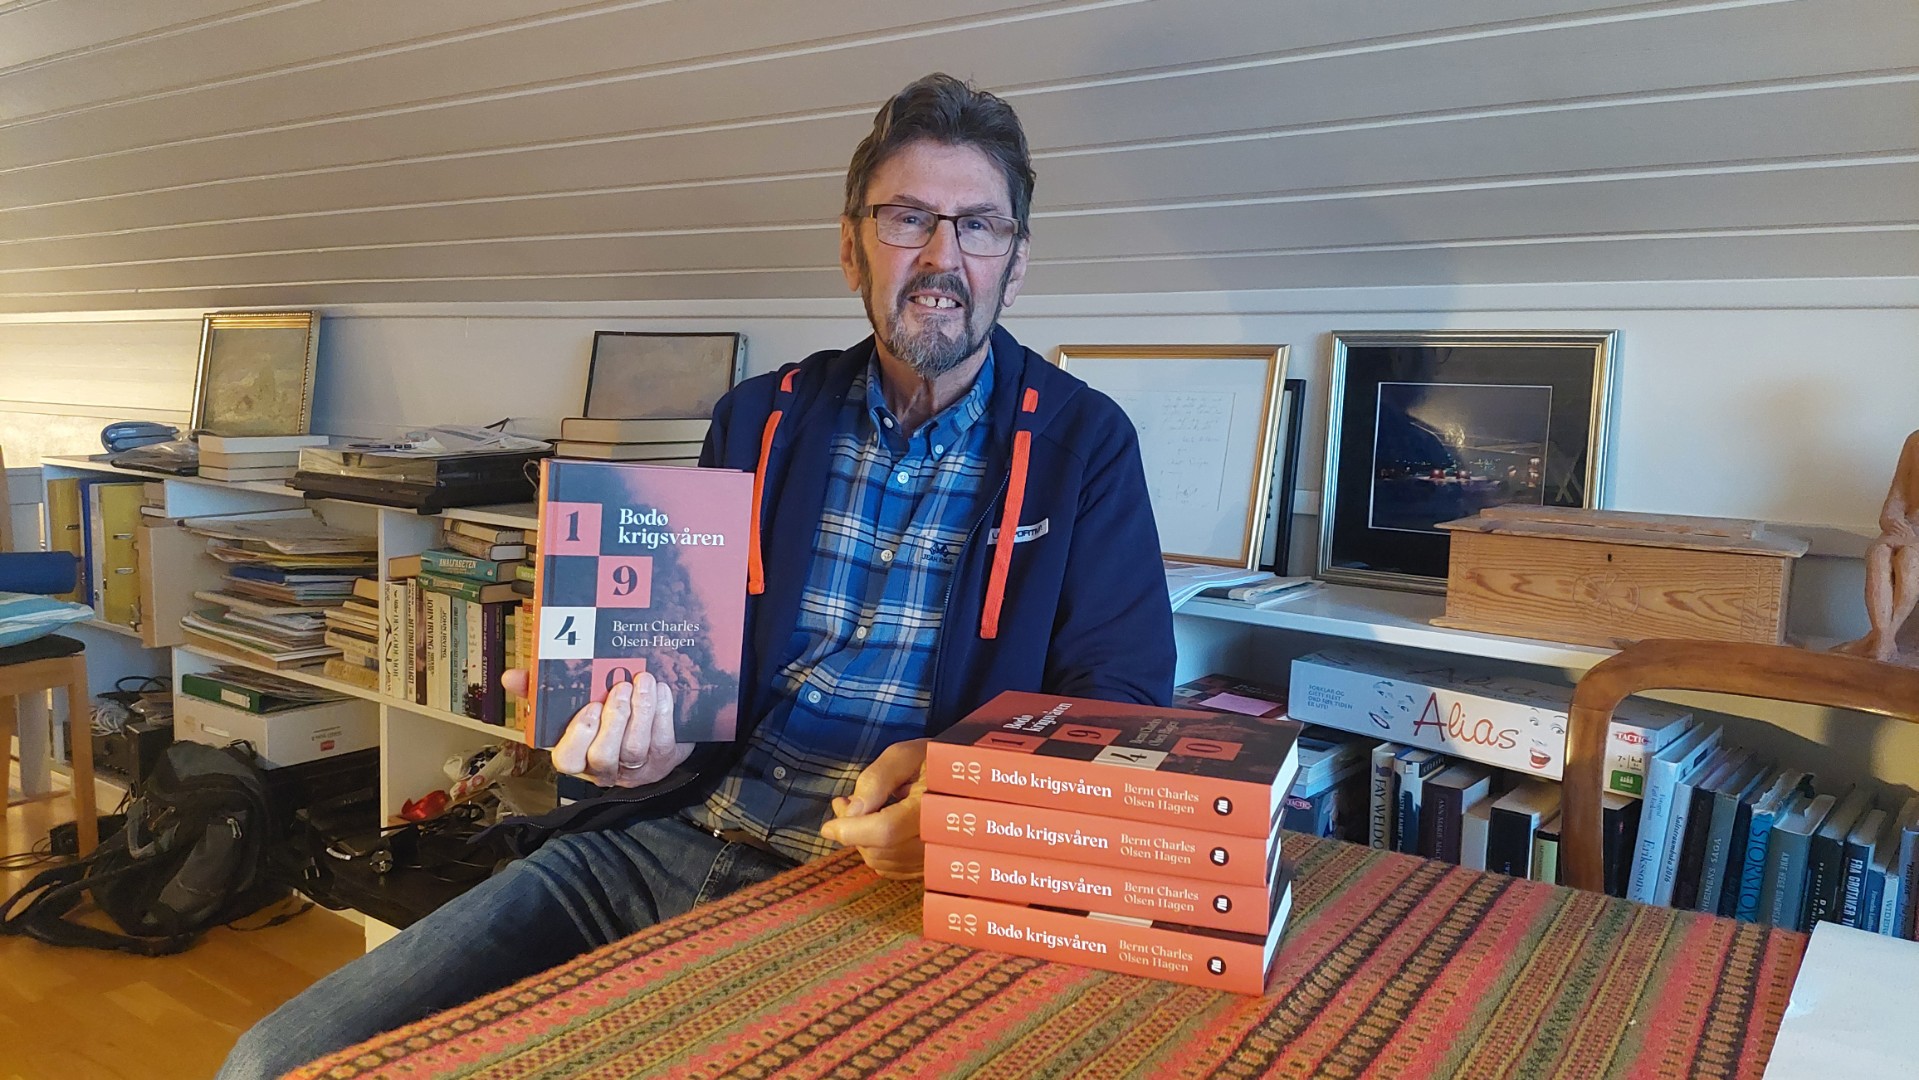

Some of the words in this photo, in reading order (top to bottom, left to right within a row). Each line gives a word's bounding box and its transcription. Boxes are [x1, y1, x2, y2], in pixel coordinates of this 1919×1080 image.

[565, 510, 581, 542] 1
[619, 508, 668, 527] Bodø
[618, 527, 725, 549] krigsvåren
[612, 565, 638, 597] 9
[553, 615, 581, 646] 4
[612, 620, 649, 632] Bernt
[652, 620, 700, 632] Charles
[612, 635, 695, 651] Olsen-Hagen
[1002, 714, 1034, 730] Bodø
[1413, 692, 1520, 750] Alias
[1066, 729, 1102, 740] 9
[1617, 732, 1648, 744] TACTIC
[1110, 752, 1148, 763] 4
[951, 761, 966, 781] 19
[967, 761, 982, 785] 40
[991, 768, 1028, 786] Bodø
[1030, 772, 1112, 798] krigsvåren
[1124, 783, 1154, 797] Bernt
[1157, 787, 1200, 802] Charles
[1374, 779, 1386, 800] FAY
[1124, 796, 1155, 809] Olsen
[1158, 800, 1195, 814] Hagen
[946, 812, 960, 833] 19
[962, 813, 977, 837] 40
[1373, 804, 1386, 850] WELDO
[986, 819, 1023, 837] Bodø
[1026, 824, 1109, 849] krigsvåren
[1120, 833, 1151, 847] Bernt
[1153, 838, 1196, 853] Charles
[1120, 846, 1151, 859] Olsen
[1155, 850, 1191, 865] Hagen
[1711, 838, 1722, 863] SAGA
[950, 861, 965, 881] 19
[966, 861, 981, 885] 40
[1665, 867, 1674, 883] 2016
[1849, 858, 1863, 875] FRA
[990, 867, 1027, 885] Bodø
[1030, 872, 1113, 897] krigsvåren
[1124, 882, 1154, 894] Bernt
[1157, 886, 1199, 901] Charles
[1124, 894, 1155, 907] Olsen
[1158, 898, 1195, 912] Hagen
[1843, 875, 1861, 916] GRØTAVÆR
[948, 913, 962, 932] 19
[964, 913, 978, 936] 40
[987, 921, 1023, 939] Bodø
[1026, 927, 1108, 954] krigsvåren
[1119, 939, 1149, 954] Bernt
[1151, 945, 1194, 961] Charles
[1118, 952, 1149, 965] Olsen
[1153, 957, 1189, 972] Hagen
